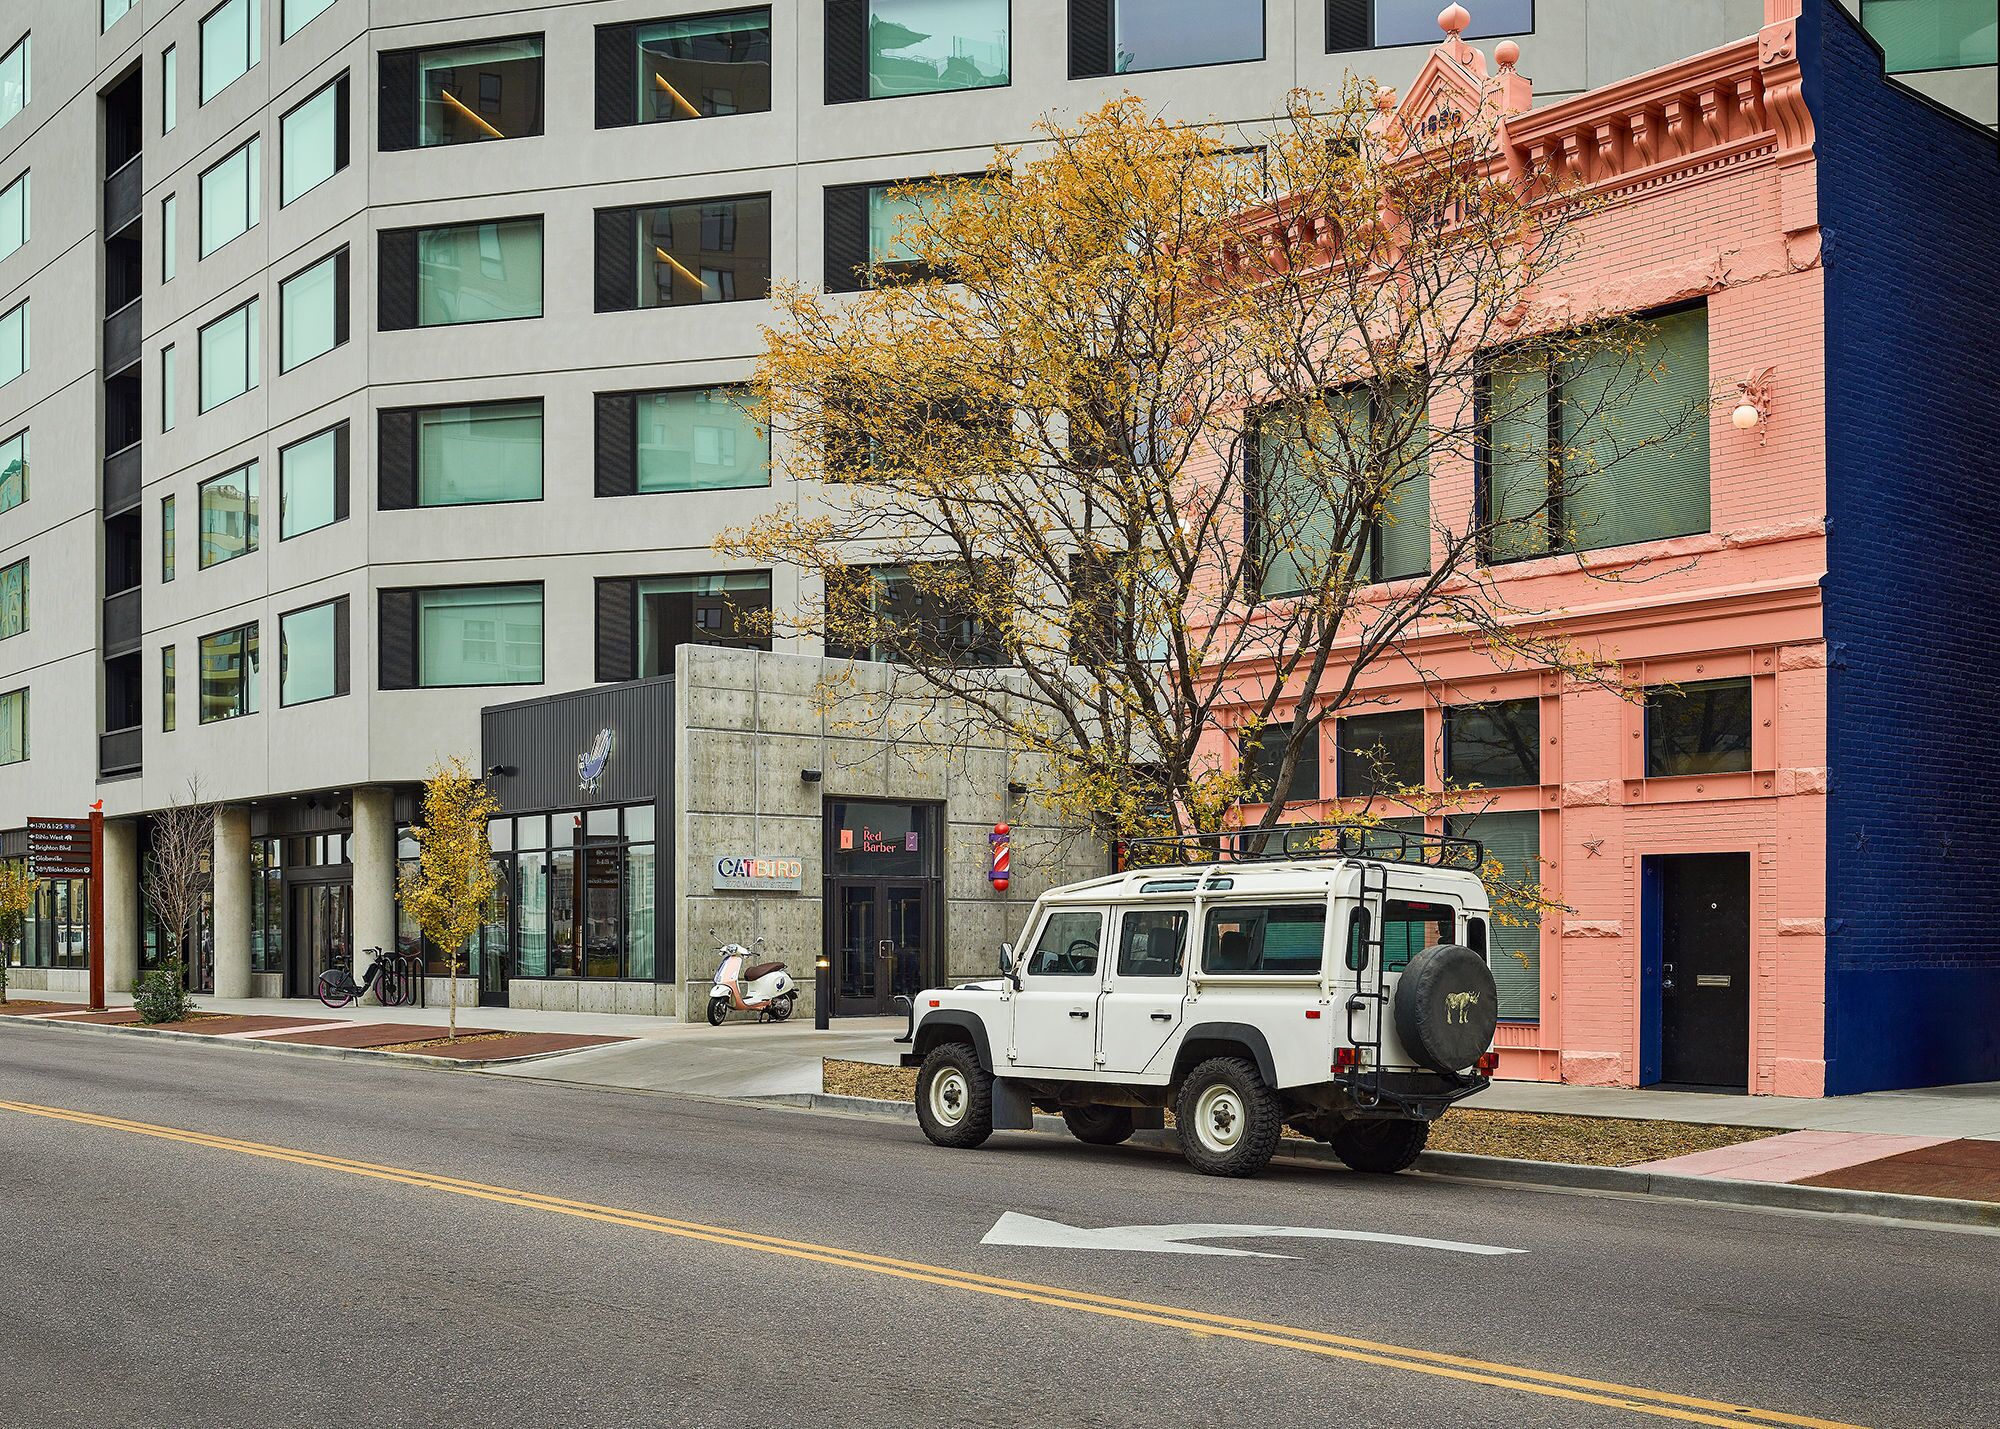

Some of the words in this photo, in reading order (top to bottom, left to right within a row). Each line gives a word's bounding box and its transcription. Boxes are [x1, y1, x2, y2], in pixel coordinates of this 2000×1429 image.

[863, 830, 882, 841] Red
[863, 841, 896, 852] Barber
[717, 857, 802, 879] CATBIRD
[770, 881, 793, 889] STREET
